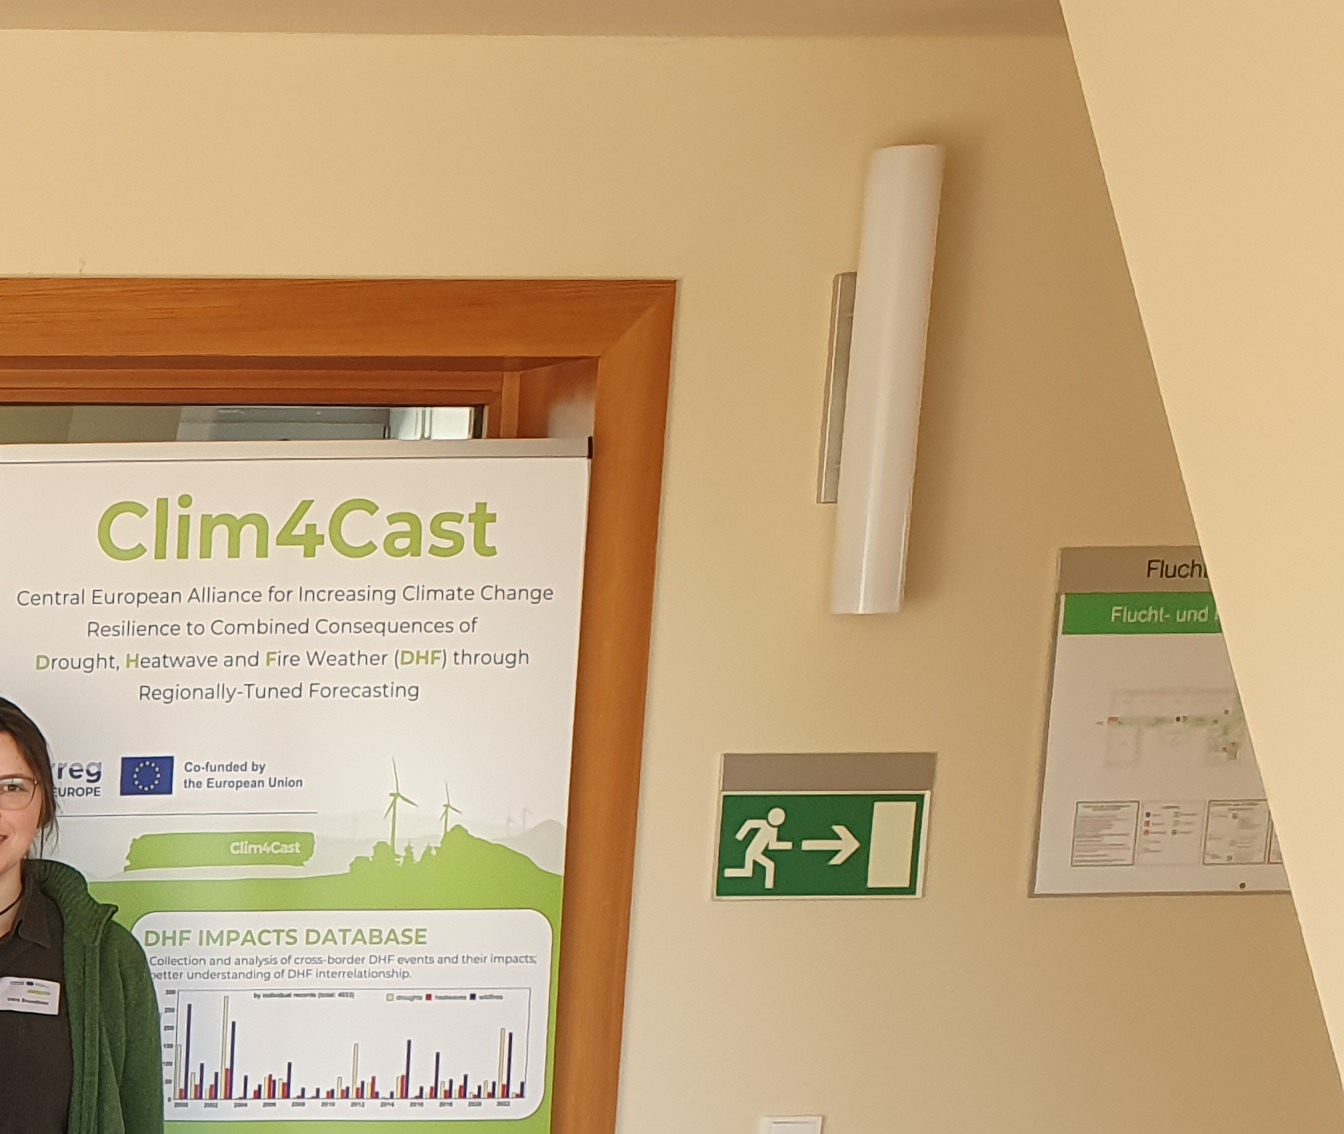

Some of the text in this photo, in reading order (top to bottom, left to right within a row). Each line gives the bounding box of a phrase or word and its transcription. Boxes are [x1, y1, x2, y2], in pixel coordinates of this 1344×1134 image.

[97, 494, 498, 561] Clim4Cast
[16, 584, 554, 608] Central European Alliance for Increasing Climate Change
[1111, 606, 1170, 622] Flucht-
[1177, 606, 1208, 622] und
[87, 616, 478, 639] Resilience to Combined Consequences of
[35, 648, 529, 674] Drought, Heatwave and Fire Weather (DHF) through
[139, 681, 420, 705] Regionally-Tuned Forecasting
[184, 762, 266, 774] Co-funded by
[184, 777, 303, 791] the European Union
[229, 841, 301, 855] Clim4Cast
[144, 928, 428, 946] DHF IMPACTS DATABASE
[149, 956, 206, 966] Collection
[209, 956, 231, 965] and
[234, 956, 278, 967] analysis
[281, 955, 292, 965] of
[294, 954, 366, 966] cross-border
[369, 955, 395, 964] DHF
[397, 955, 434, 964] events
[437, 954, 458, 964] and
[462, 954, 487, 964] their
[187, 968, 412, 981] understanding of DHF interrelationship.
